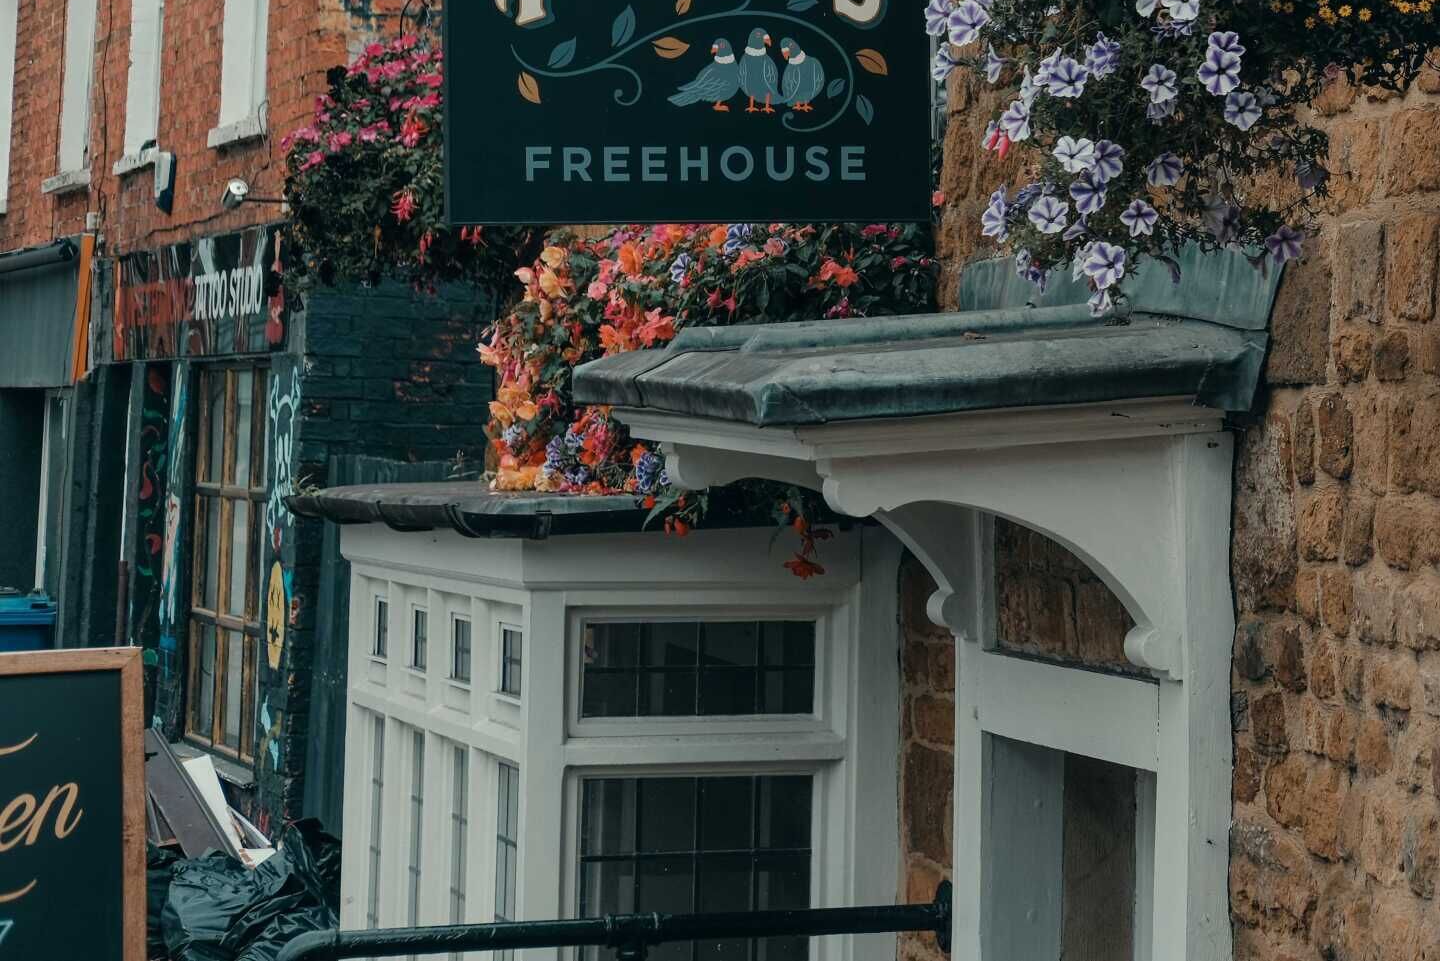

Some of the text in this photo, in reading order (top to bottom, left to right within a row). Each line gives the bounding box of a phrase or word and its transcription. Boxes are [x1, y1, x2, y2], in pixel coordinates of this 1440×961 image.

[524, 145, 867, 183] FREEHOUSE
[195, 270, 228, 320] TATTOO
[228, 264, 263, 317] STUDIO
